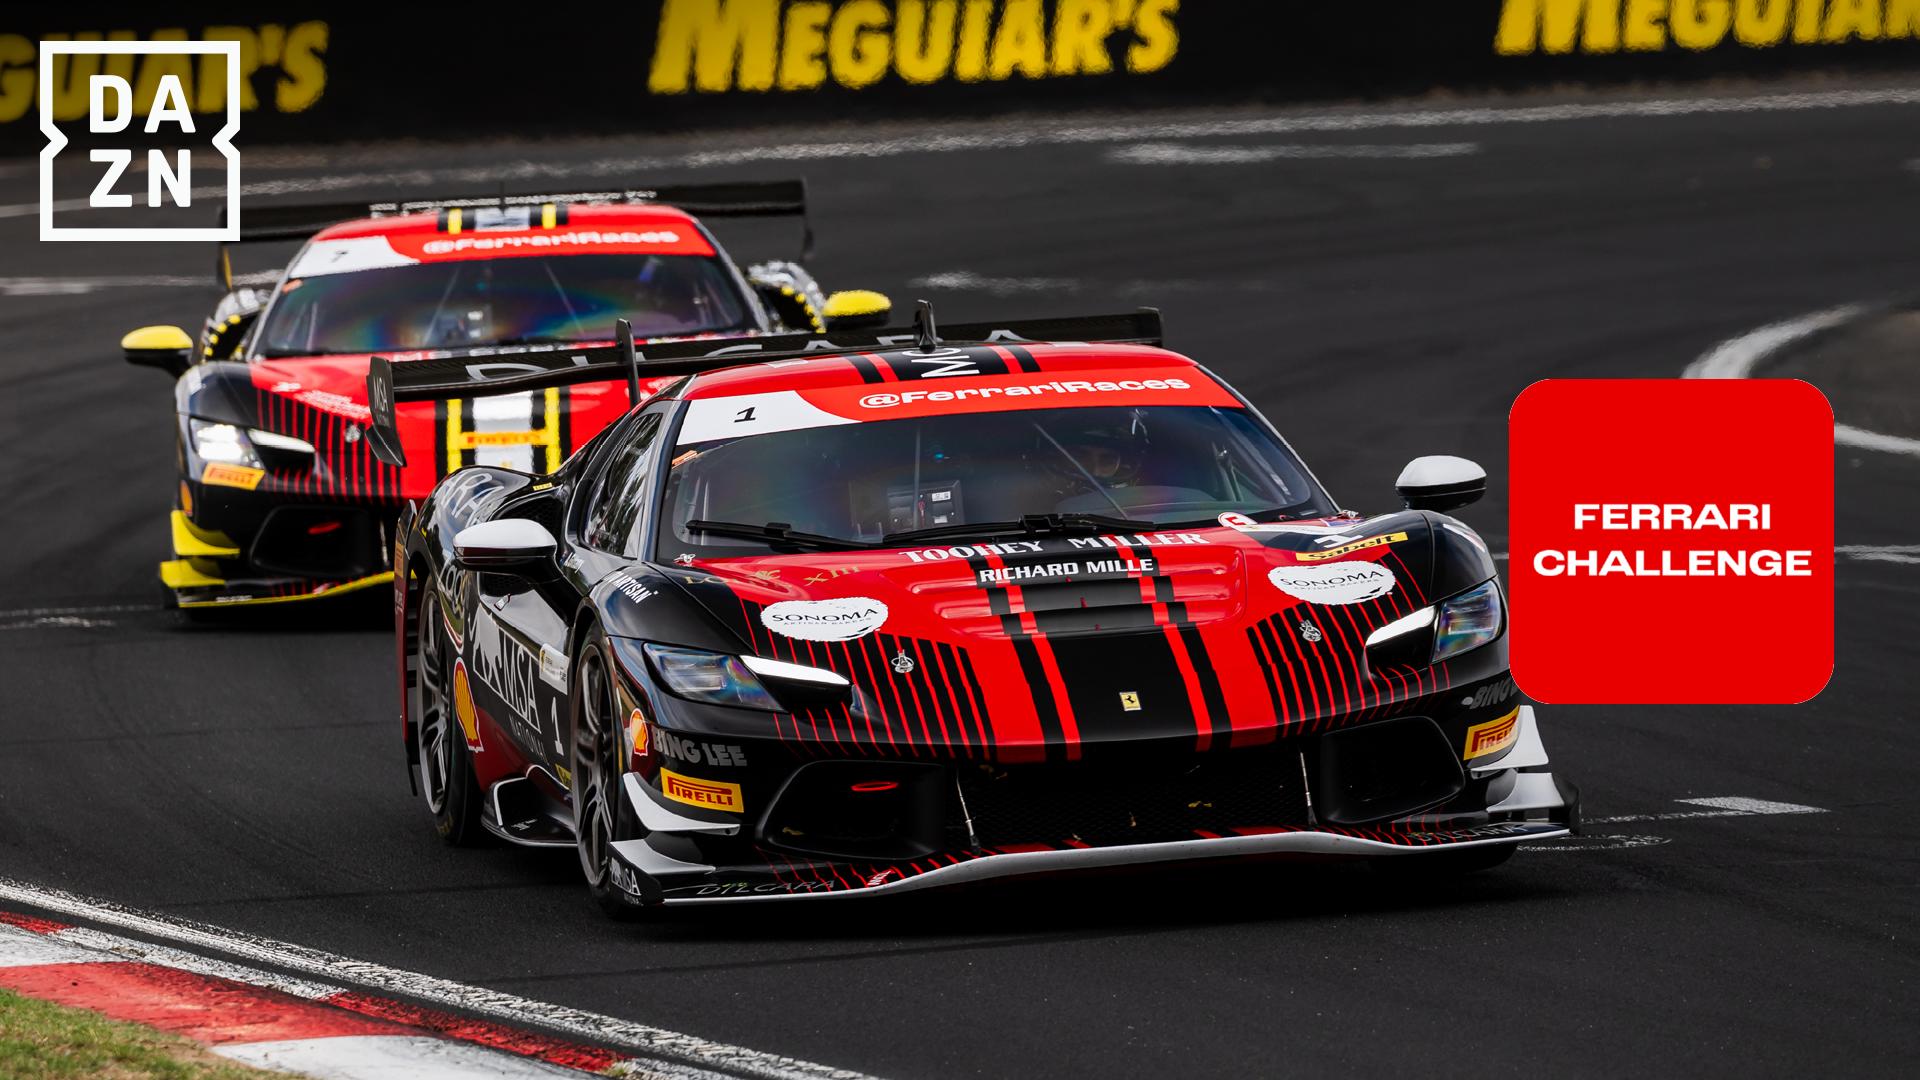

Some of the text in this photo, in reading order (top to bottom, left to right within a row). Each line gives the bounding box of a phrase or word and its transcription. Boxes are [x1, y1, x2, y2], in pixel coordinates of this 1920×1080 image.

[647, 0, 1180, 95] MEGUIAR'S
[858, 376, 1192, 410] @FerrariRaces
[733, 406, 757, 424] 1
[898, 532, 1210, 564] TOOHEY MILLER
[1307, 534, 1396, 560] Sabelt
[979, 557, 1155, 583] RICHARD MILLE
[1280, 570, 1385, 588] SONOMA
[771, 608, 879, 623] SONOMA
[550, 696, 565, 757] 1
[651, 725, 748, 767] BING LEE
[667, 776, 735, 806] PIRELLI
